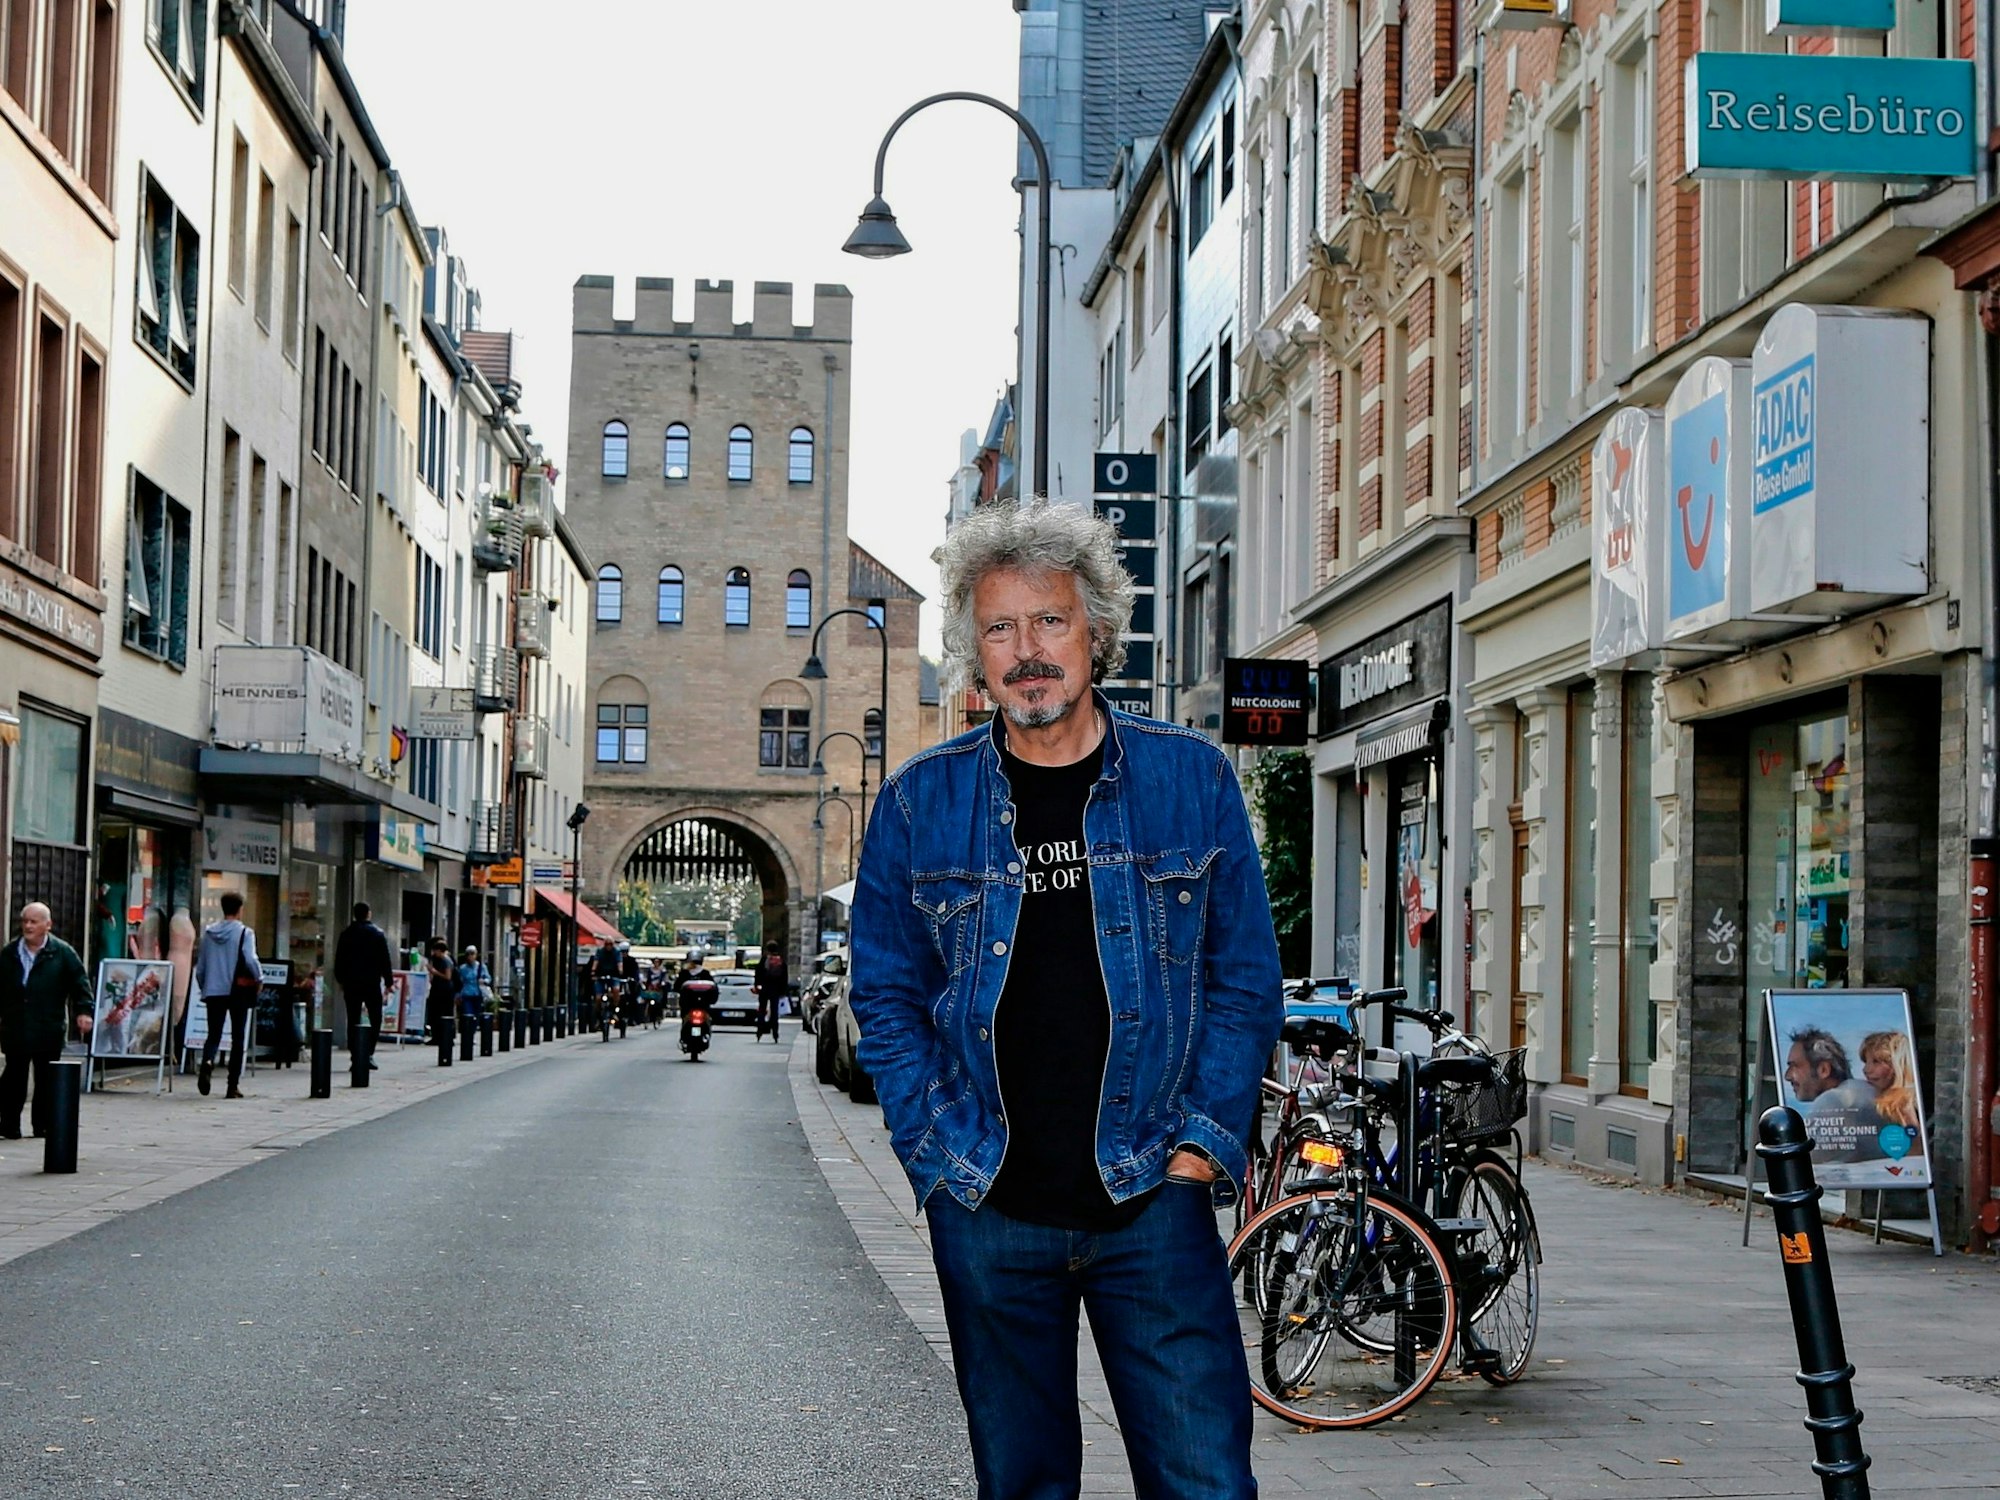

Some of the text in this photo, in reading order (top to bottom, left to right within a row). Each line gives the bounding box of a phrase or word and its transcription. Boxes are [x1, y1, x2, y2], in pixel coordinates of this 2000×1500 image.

[1706, 90, 1964, 137] Reisebüro
[1757, 375, 1810, 461] ADAC
[1756, 449, 1811, 504] Reise GmbH
[27, 588, 63, 633] ESCH
[222, 688, 299, 699] HENNES
[1231, 696, 1302, 709] NETCOLOGNE
[320, 686, 353, 728] HENNES
[231, 843, 277, 866] HENNES
[1052, 867, 1083, 890] OF
[1805, 1126, 1878, 1136] IT DER SONNE
[1814, 1117, 1845, 1127] ZWEIT
